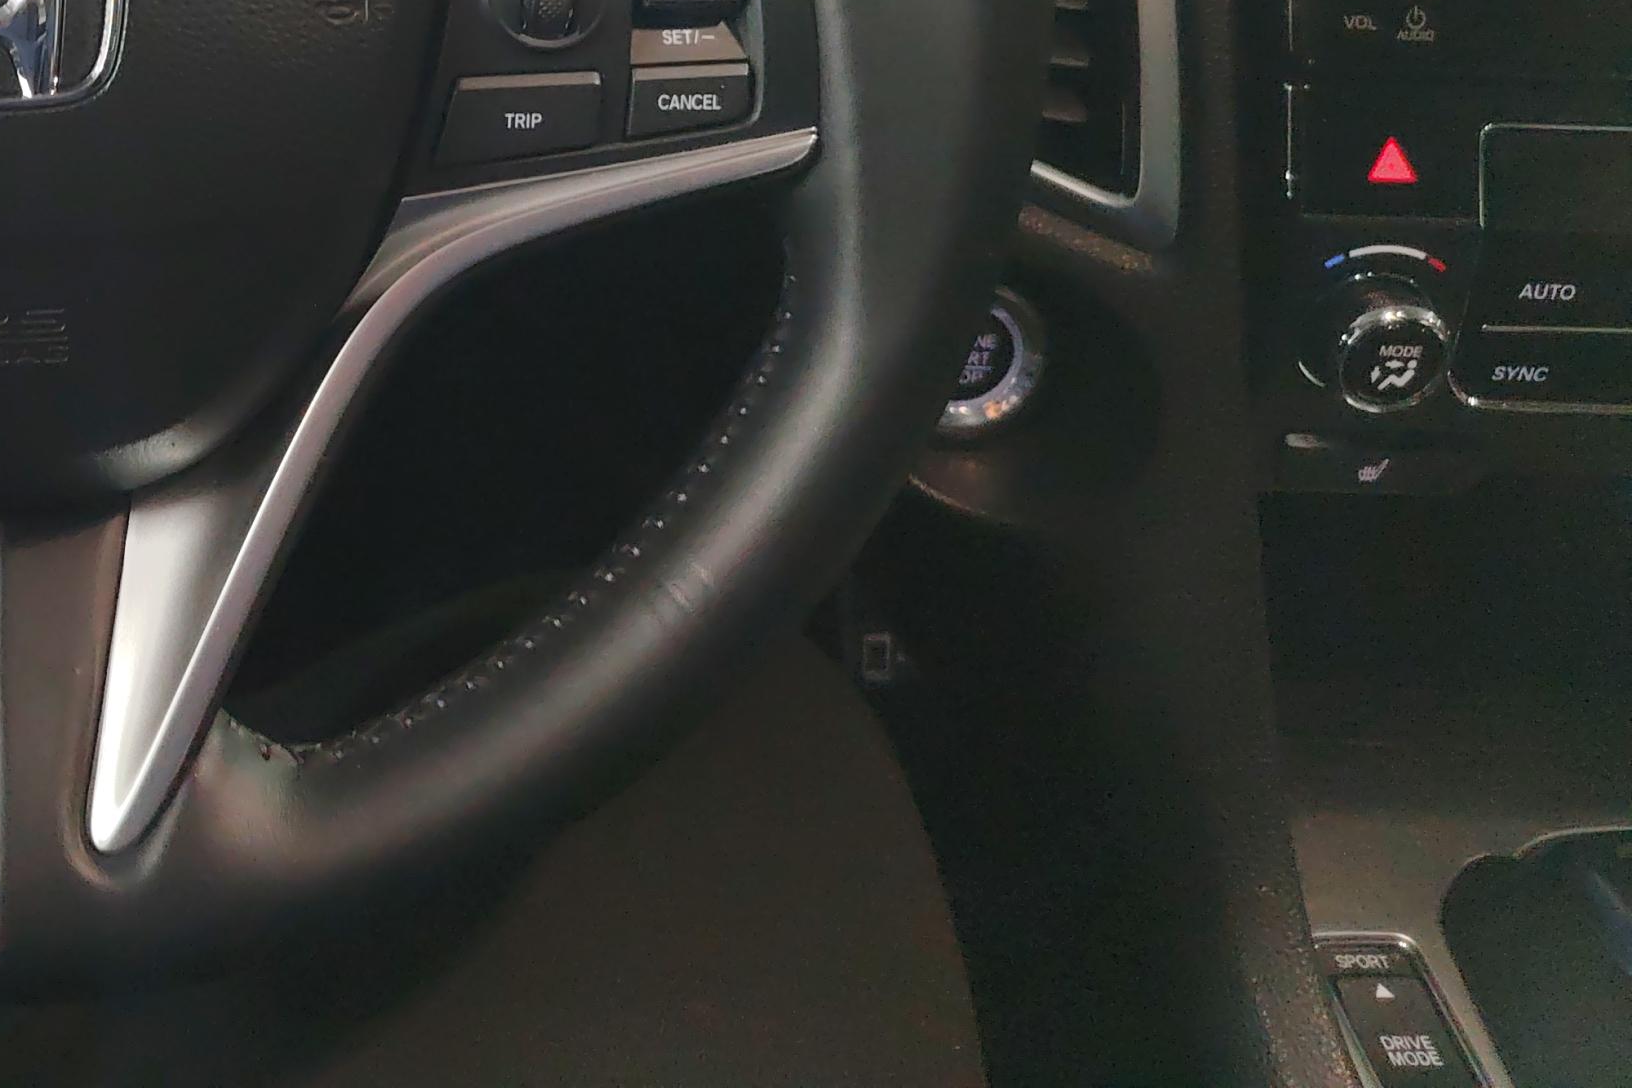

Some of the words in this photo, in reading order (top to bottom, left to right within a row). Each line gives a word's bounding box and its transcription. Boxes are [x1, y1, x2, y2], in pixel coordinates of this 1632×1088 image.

[1344, 16, 1376, 30] VOL
[657, 94, 722, 111] CANCEL
[505, 113, 542, 129] TRIP
[1519, 284, 1576, 300] AUTO
[1379, 345, 1423, 359] MODE
[1493, 366, 1548, 382] SYNC
[1335, 955, 1389, 969] SPORT
[1380, 1035, 1433, 1050] DRIVE
[1388, 1051, 1443, 1066] MODE
